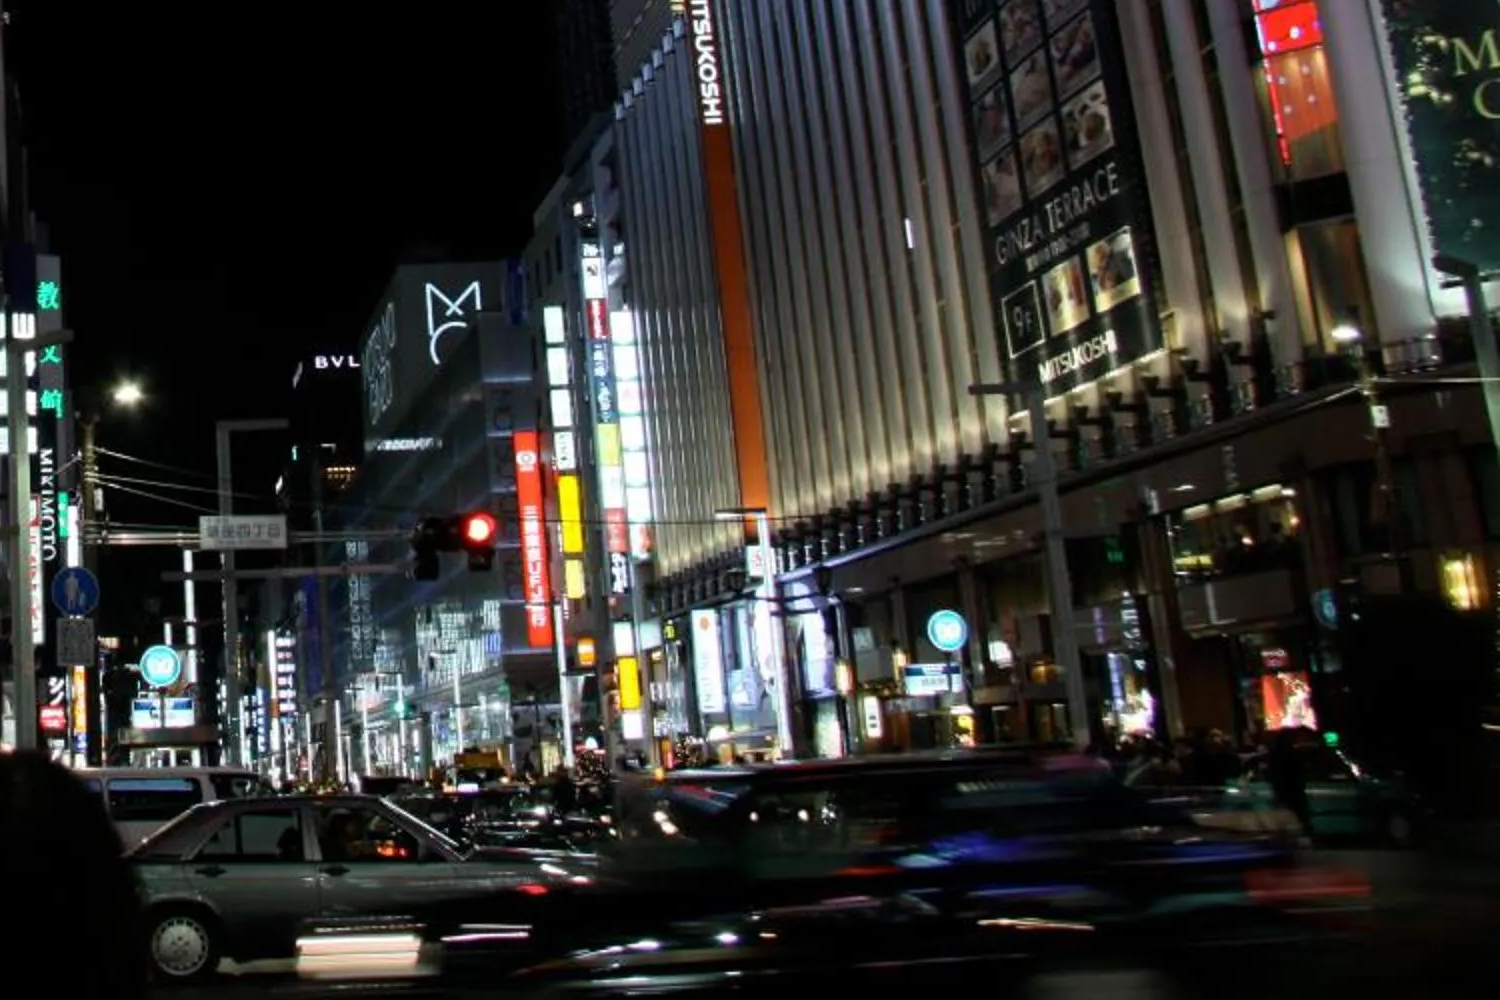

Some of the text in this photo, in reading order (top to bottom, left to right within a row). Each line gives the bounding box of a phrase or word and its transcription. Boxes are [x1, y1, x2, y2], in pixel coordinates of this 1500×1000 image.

[995, 214, 1046, 265] GINZA
[1045, 161, 1120, 233] TERRACE
[1038, 328, 1119, 384] MITSUKOSHI
[39, 448, 57, 561] MIKIMOTO
